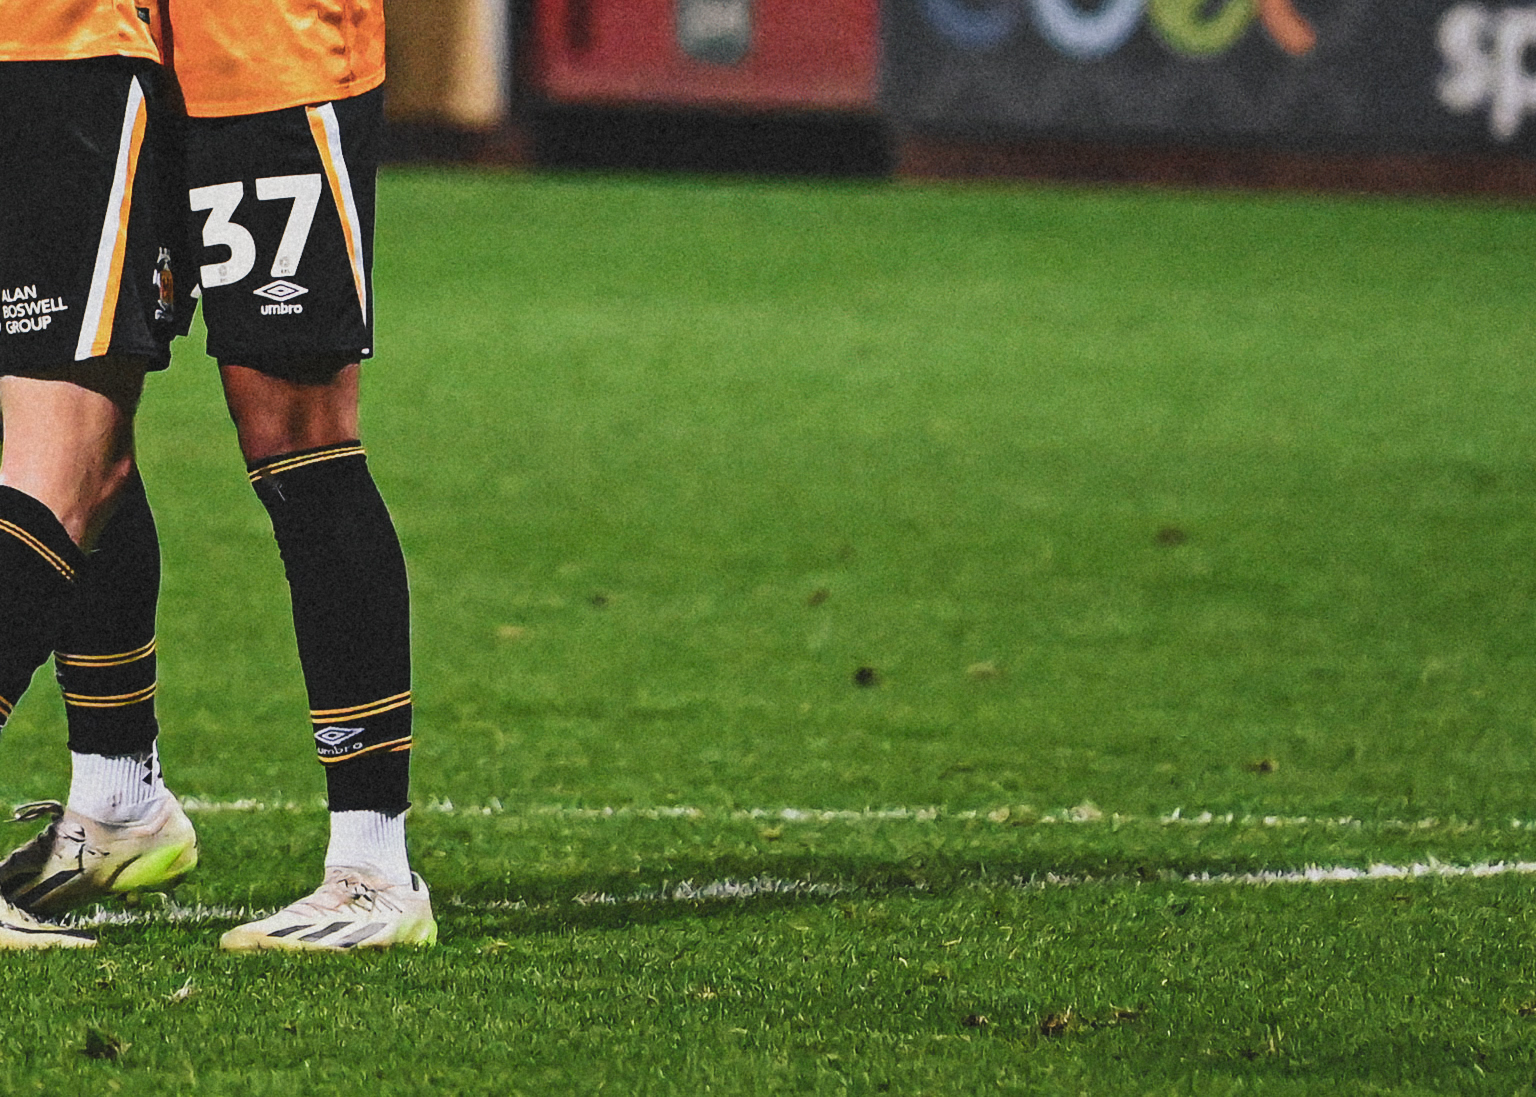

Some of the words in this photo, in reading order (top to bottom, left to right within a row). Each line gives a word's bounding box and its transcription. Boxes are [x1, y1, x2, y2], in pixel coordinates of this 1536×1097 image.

[189, 173, 322, 289] 37
[2, 284, 37, 302] ALAN
[2, 296, 68, 319] BOSWELL
[260, 302, 303, 315] umbro
[5, 315, 52, 334] GROUP
